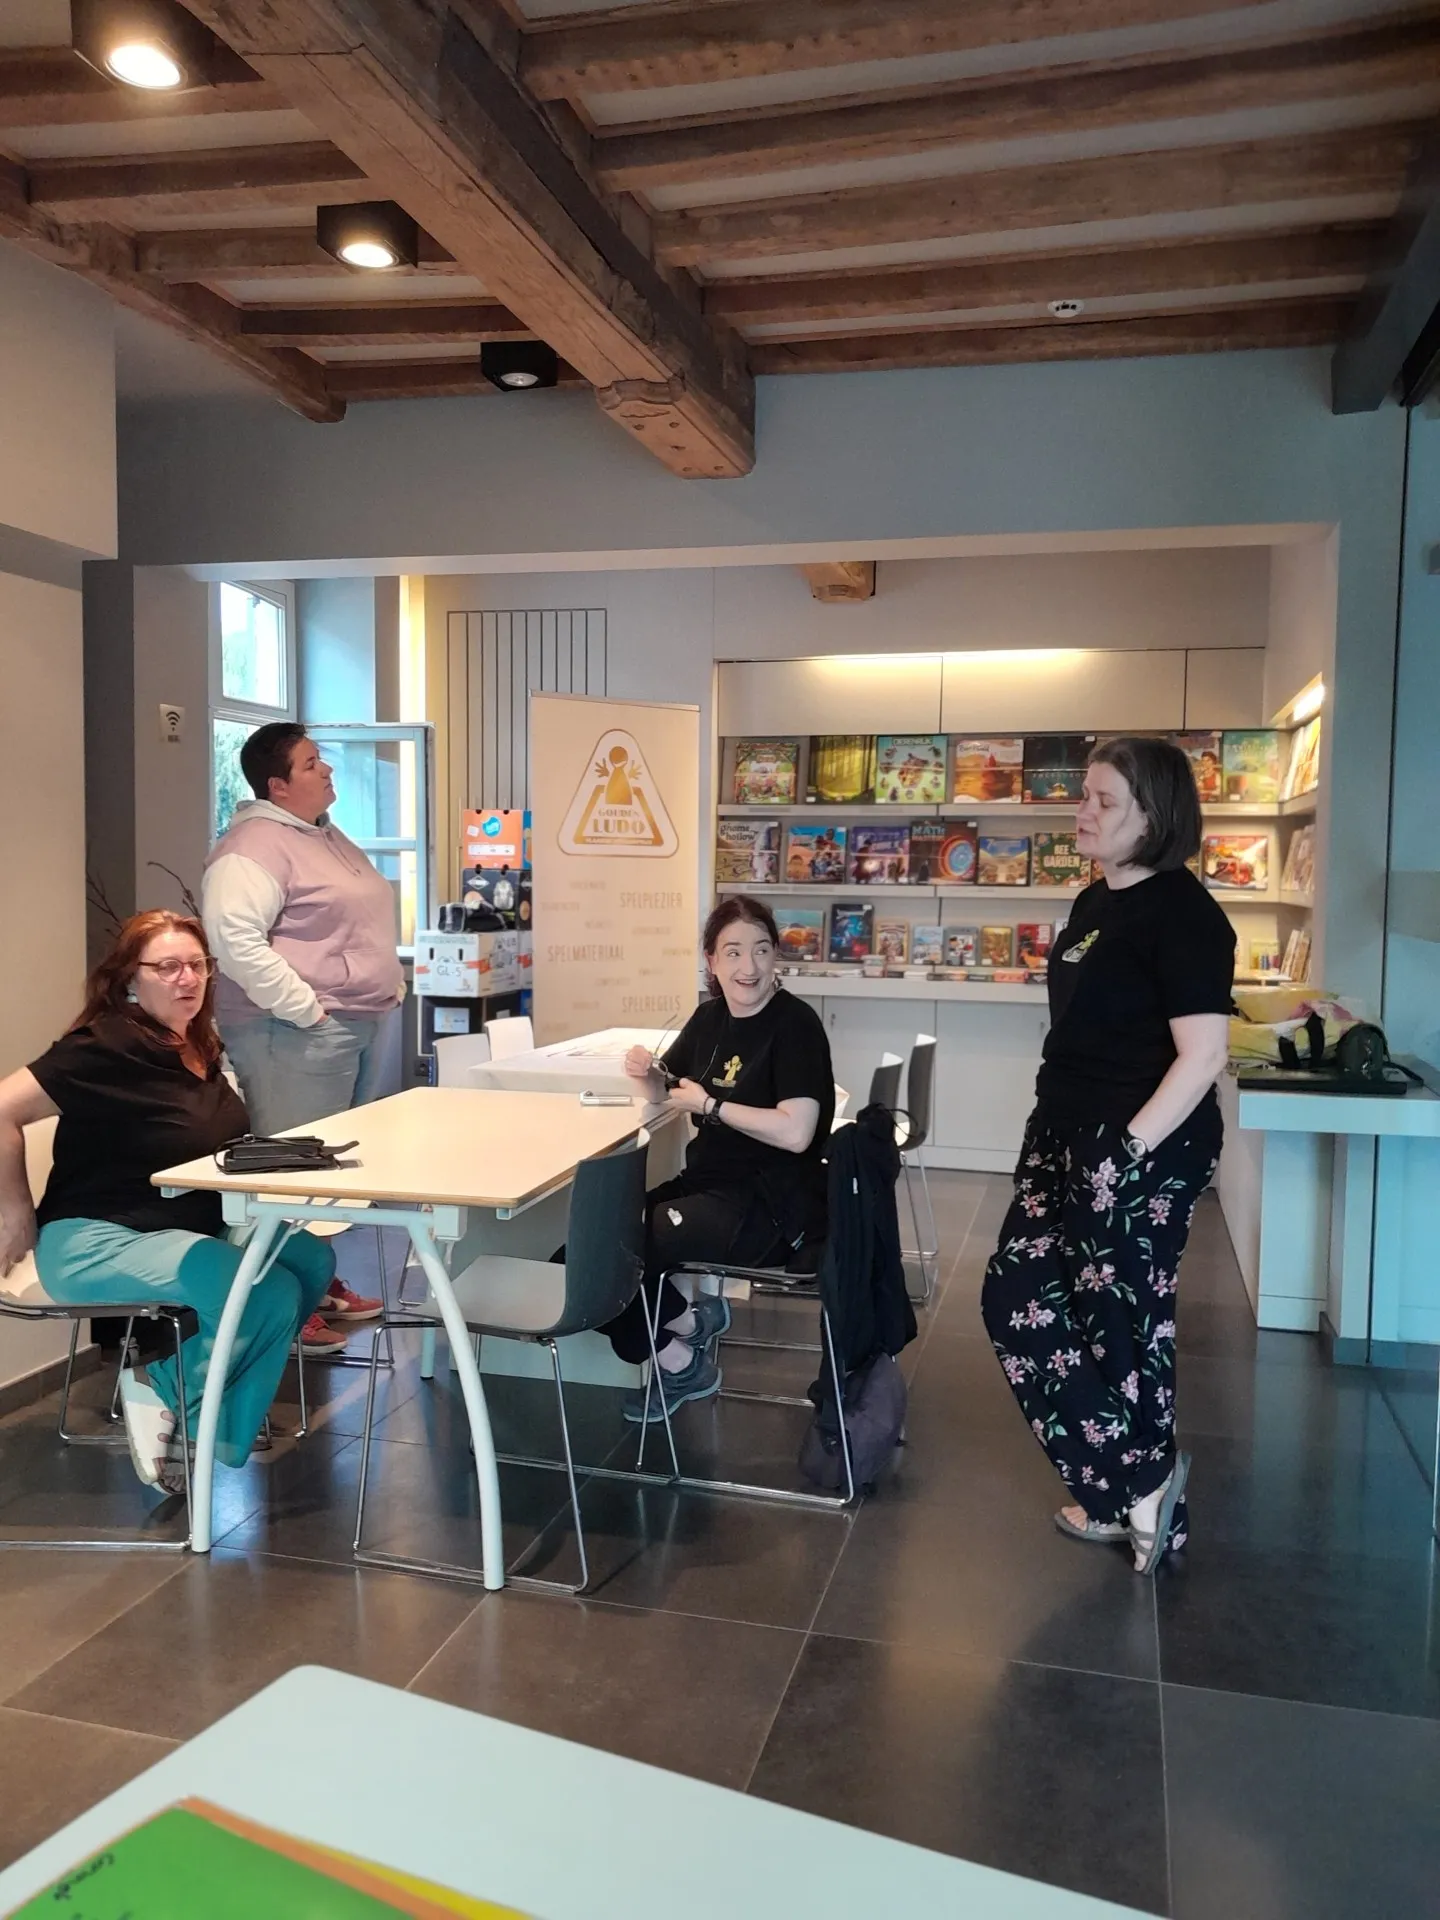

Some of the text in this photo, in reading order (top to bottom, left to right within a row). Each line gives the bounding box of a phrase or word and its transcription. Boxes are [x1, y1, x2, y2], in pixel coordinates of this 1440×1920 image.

[593, 818, 645, 835] LUDO
[726, 831, 756, 841] hollow
[1054, 845, 1070, 855] BEE
[1043, 855, 1080, 868] GARDEN
[620, 892, 683, 909] SPELPLEZIER
[547, 945, 625, 963] SPELMATERIAAL
[622, 995, 681, 1013] SPELREGELS
